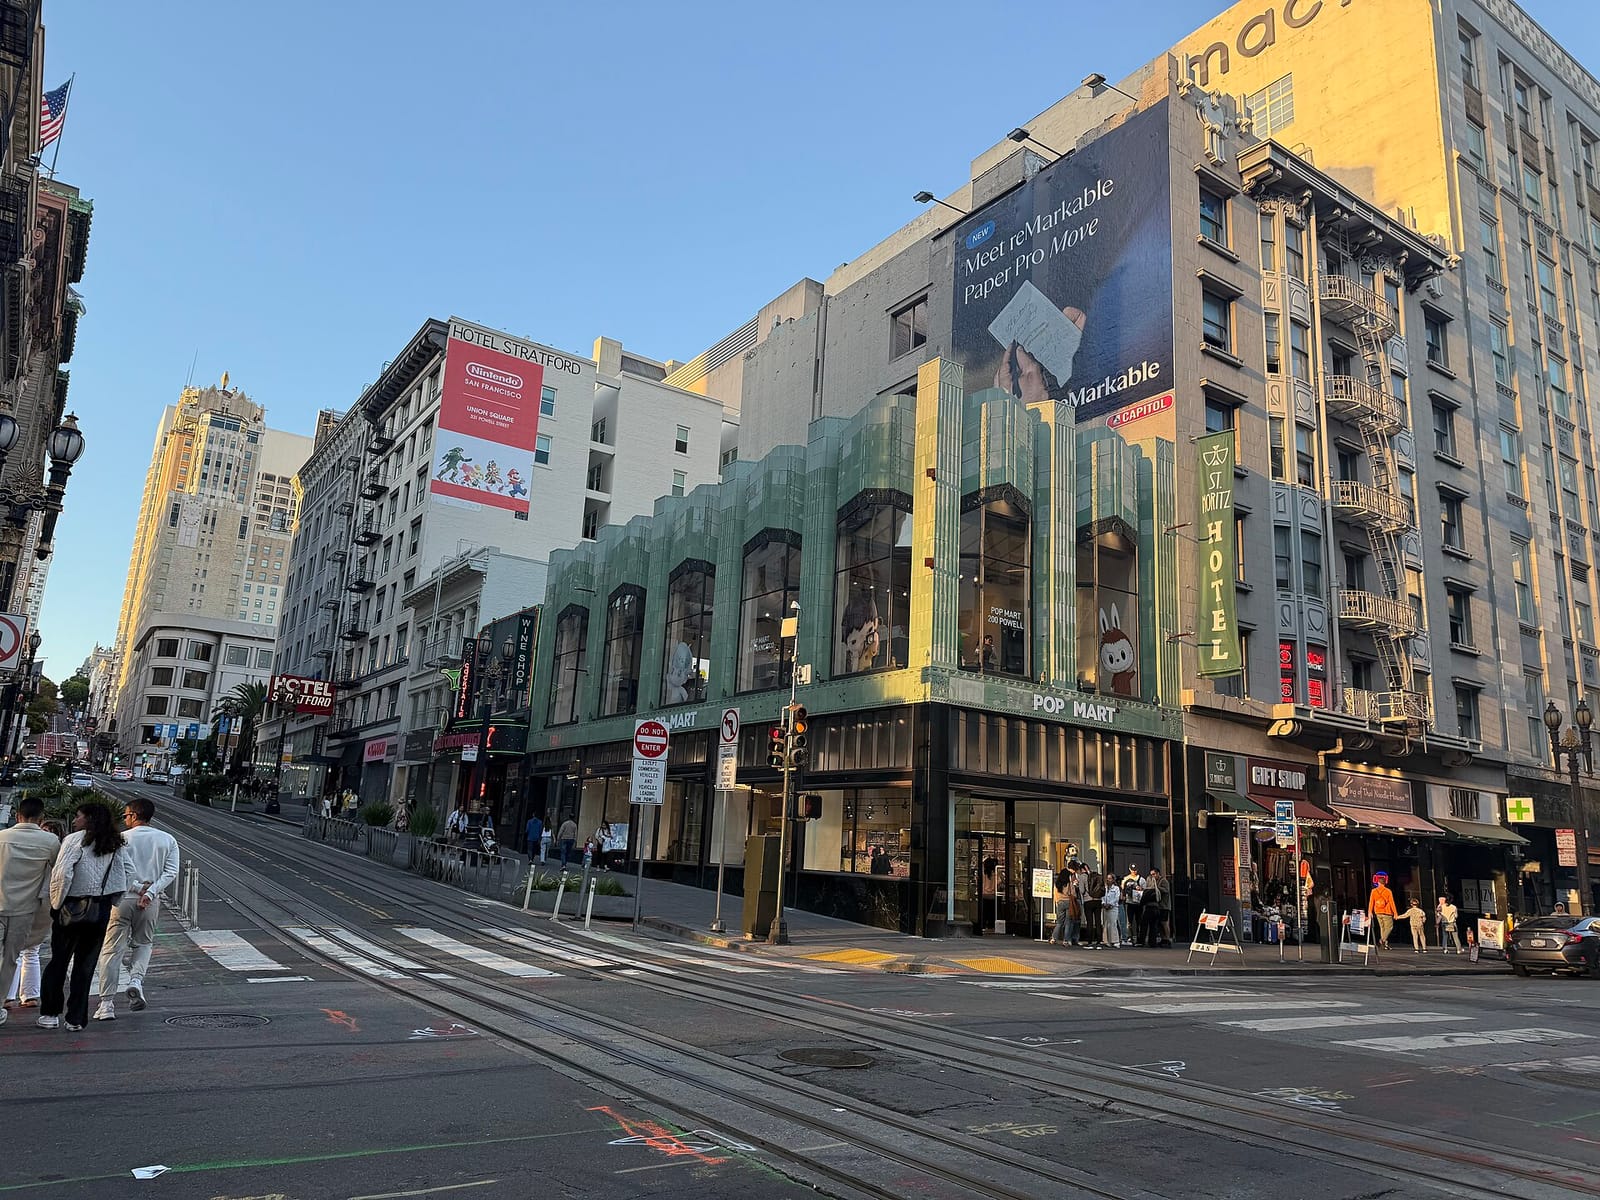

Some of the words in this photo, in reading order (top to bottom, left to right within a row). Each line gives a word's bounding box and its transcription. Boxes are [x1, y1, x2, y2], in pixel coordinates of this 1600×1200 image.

[1189, 0, 1351, 87] mac
[965, 241, 1004, 277] Meet
[1010, 179, 1114, 251] reMarkable
[972, 226, 990, 243] NEW
[964, 266, 1012, 305] Paper
[1015, 248, 1044, 276] Pro
[1049, 217, 1099, 258] Move
[453, 325, 498, 351] HOTEL
[502, 341, 581, 375] STRATFORD
[471, 366, 519, 386] Nintendo
[465, 378, 479, 388] SAN
[481, 382, 522, 400] FRANCISCO
[466, 405, 489, 417] UNION
[489, 411, 515, 424] SQUARE
[1122, 399, 1168, 422] CAPITOL
[1208, 471, 1223, 490] ST.
[1202, 490, 1231, 514] MORITZ
[1207, 520, 1229, 660] HOTEL
[988, 614, 998, 624] 200
[999, 617, 1024, 630] POWELL
[991, 606, 1003, 616] POP
[1004, 609, 1021, 620] MART
[519, 618, 532, 651] WINE
[515, 654, 526, 686] SHOP
[273, 676, 332, 697] HOTEL
[1033, 693, 1065, 715] POP
[1073, 701, 1116, 723] MART
[669, 711, 698, 729] MART
[640, 727, 649, 735] DO
[652, 728, 664, 736] NOT
[641, 744, 661, 752] ENTER
[1252, 766, 1277, 787] GIFT
[1278, 769, 1306, 791] SHOP
